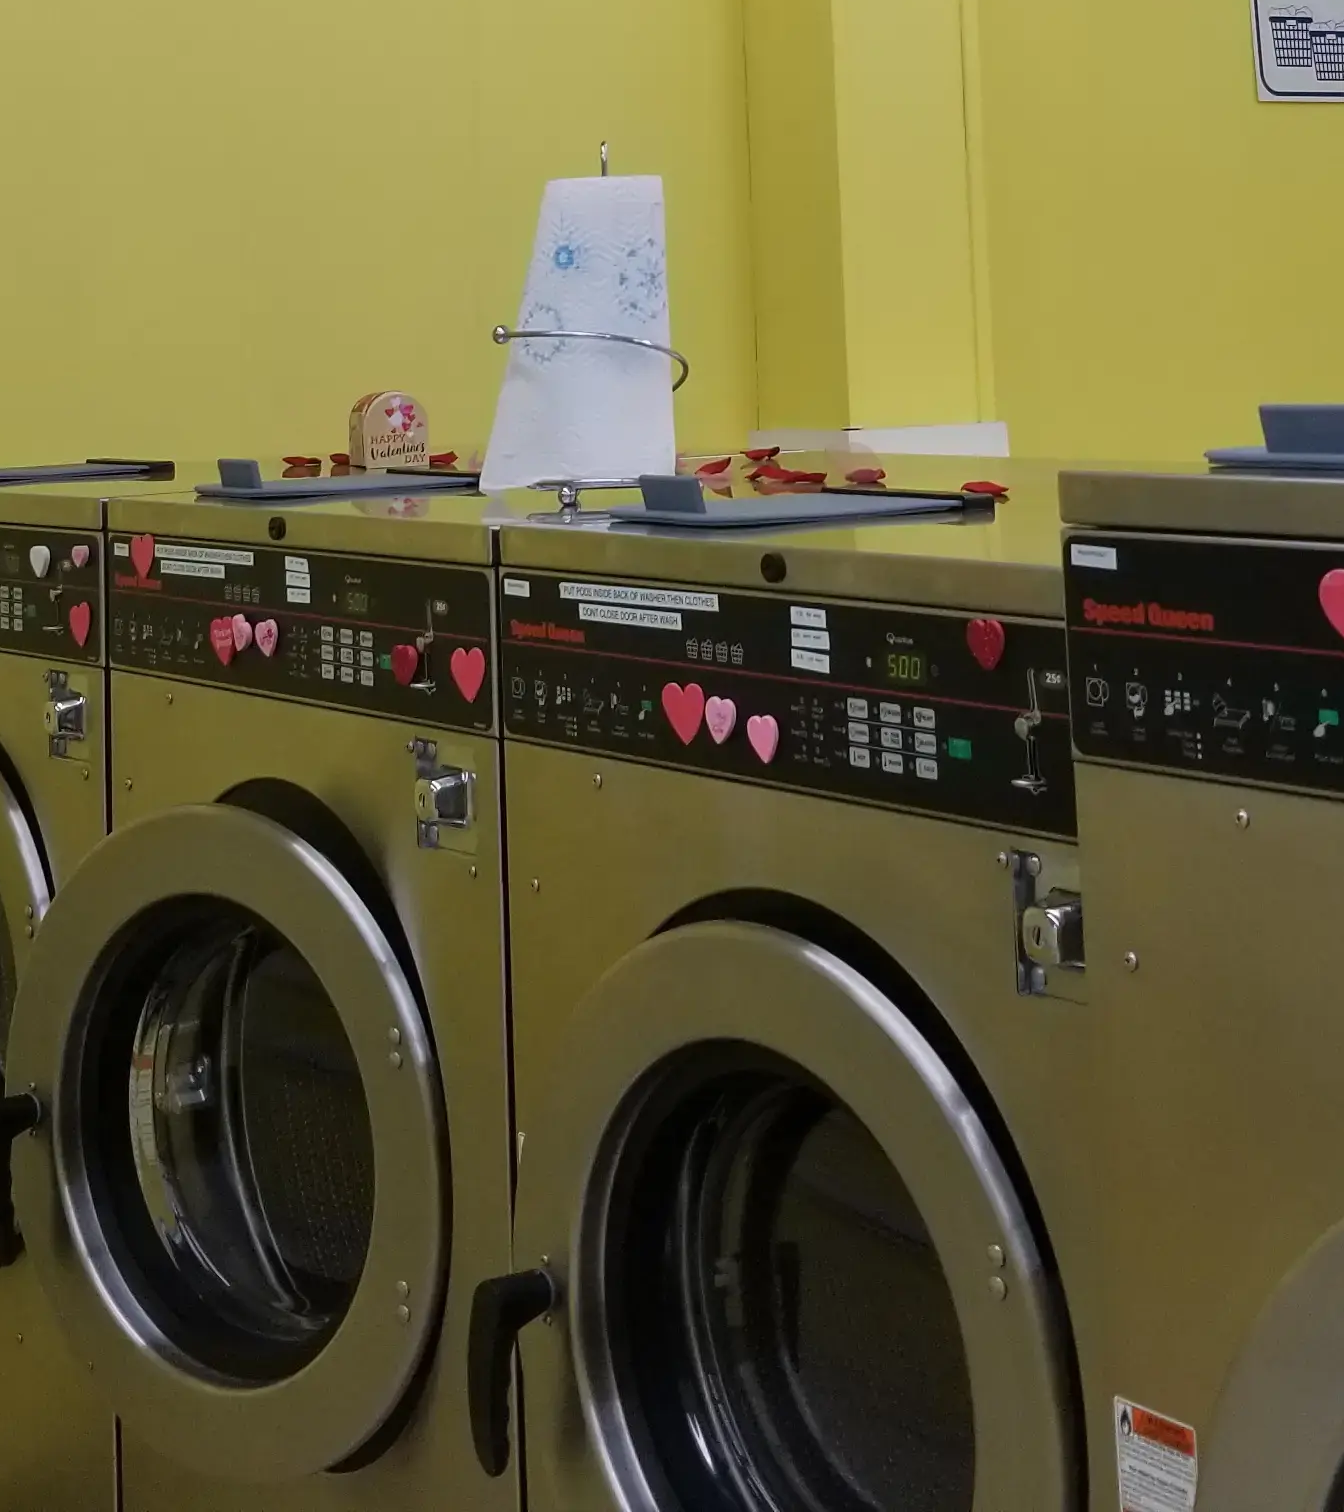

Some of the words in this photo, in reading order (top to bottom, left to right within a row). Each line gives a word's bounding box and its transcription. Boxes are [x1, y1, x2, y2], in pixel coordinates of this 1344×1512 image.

[370, 433, 406, 445] HAPPY
[404, 453, 426, 464] DAY
[887, 653, 921, 680] 500
